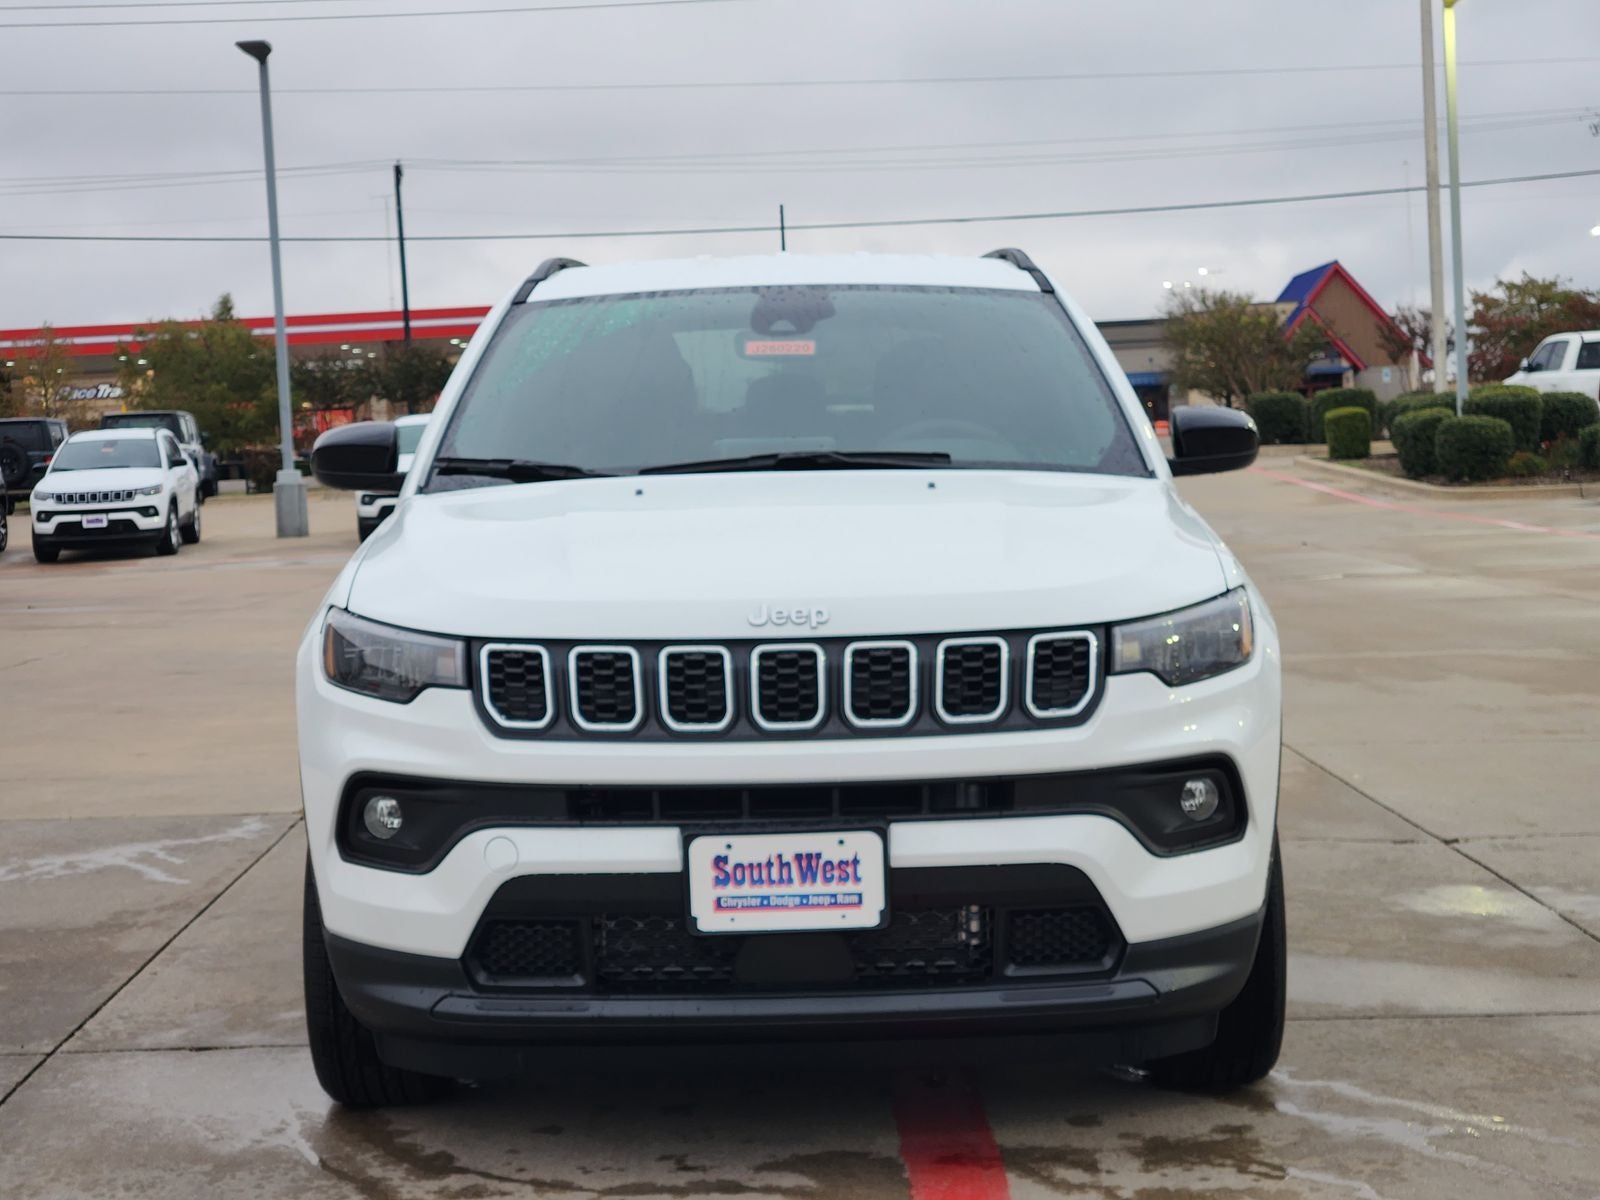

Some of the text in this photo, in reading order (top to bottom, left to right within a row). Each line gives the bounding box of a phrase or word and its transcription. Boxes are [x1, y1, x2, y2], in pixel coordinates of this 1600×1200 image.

[747, 604, 831, 629] Jeep
[720, 894, 859, 908] Chrysler Dodge Jeep Ram
